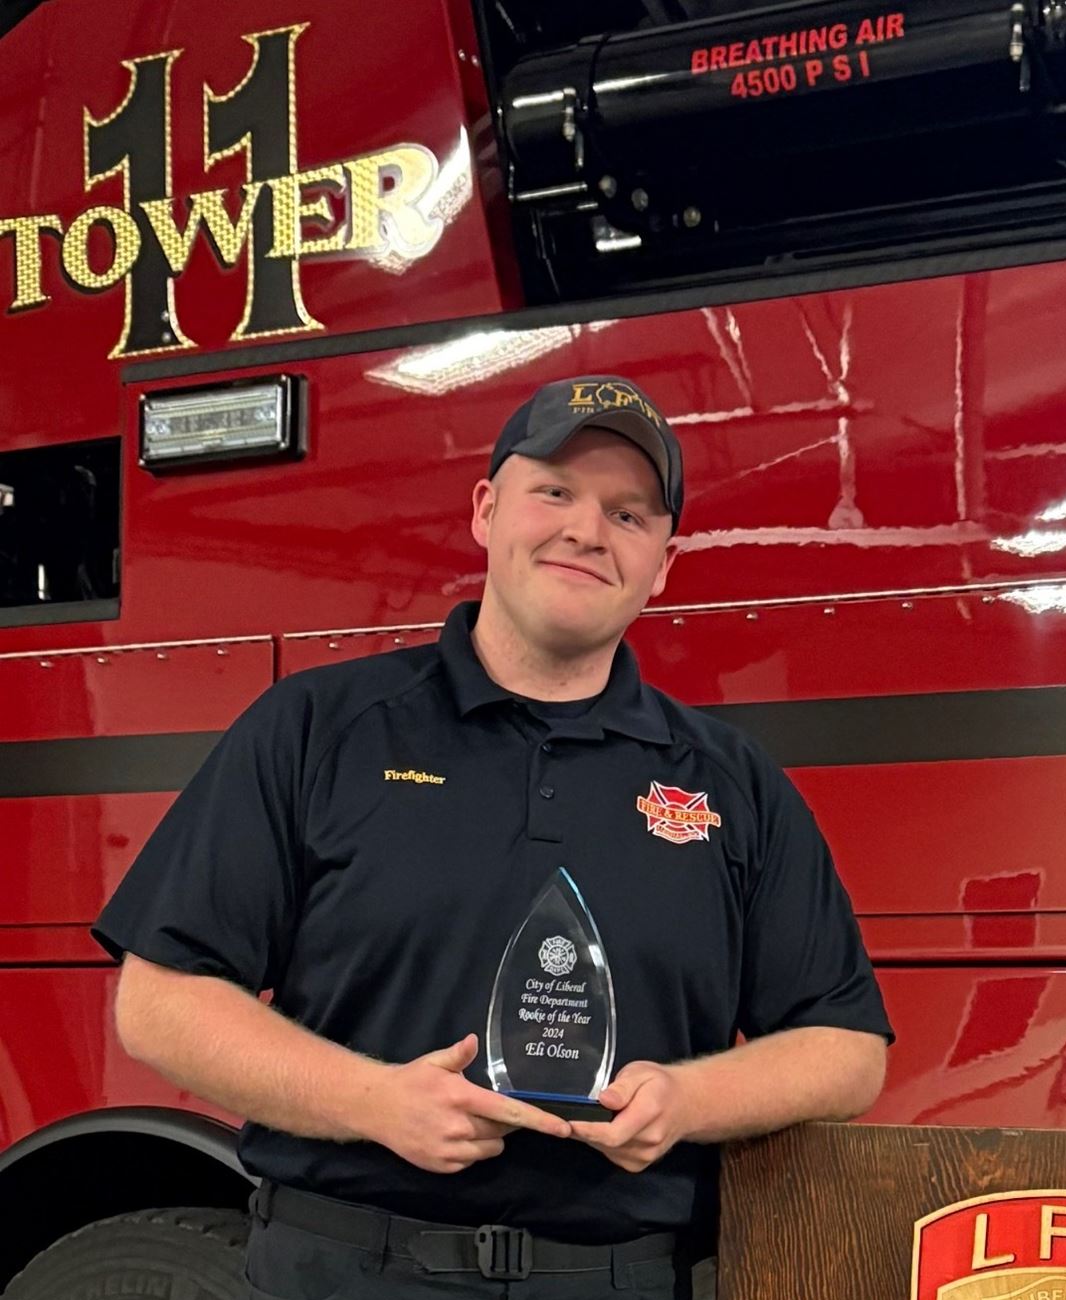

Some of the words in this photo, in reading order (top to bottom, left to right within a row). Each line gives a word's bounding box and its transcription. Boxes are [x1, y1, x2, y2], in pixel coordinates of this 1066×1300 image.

[690, 23, 847, 75] BREATHING
[855, 13, 905, 45] AIR
[731, 64, 797, 98] 4500
[84, 22, 325, 359] 11
[0, 144, 444, 309] TOWER
[384, 769, 446, 785] Firefighter
[641, 800, 662, 816] FIRE
[675, 812, 718, 824] RESCUE
[526, 978, 544, 993] City
[544, 979, 556, 993] of
[555, 980, 587, 993] Liberal
[521, 993, 539, 1004] Fire
[539, 994, 588, 1008] Department
[519, 1007, 546, 1023] Rookie
[547, 1010, 558, 1025] of
[558, 1010, 571, 1023] the
[572, 1012, 591, 1024] Year
[542, 1027, 565, 1039] 2024
[525, 1041, 545, 1056] Eli
[547, 1043, 579, 1060] Olson
